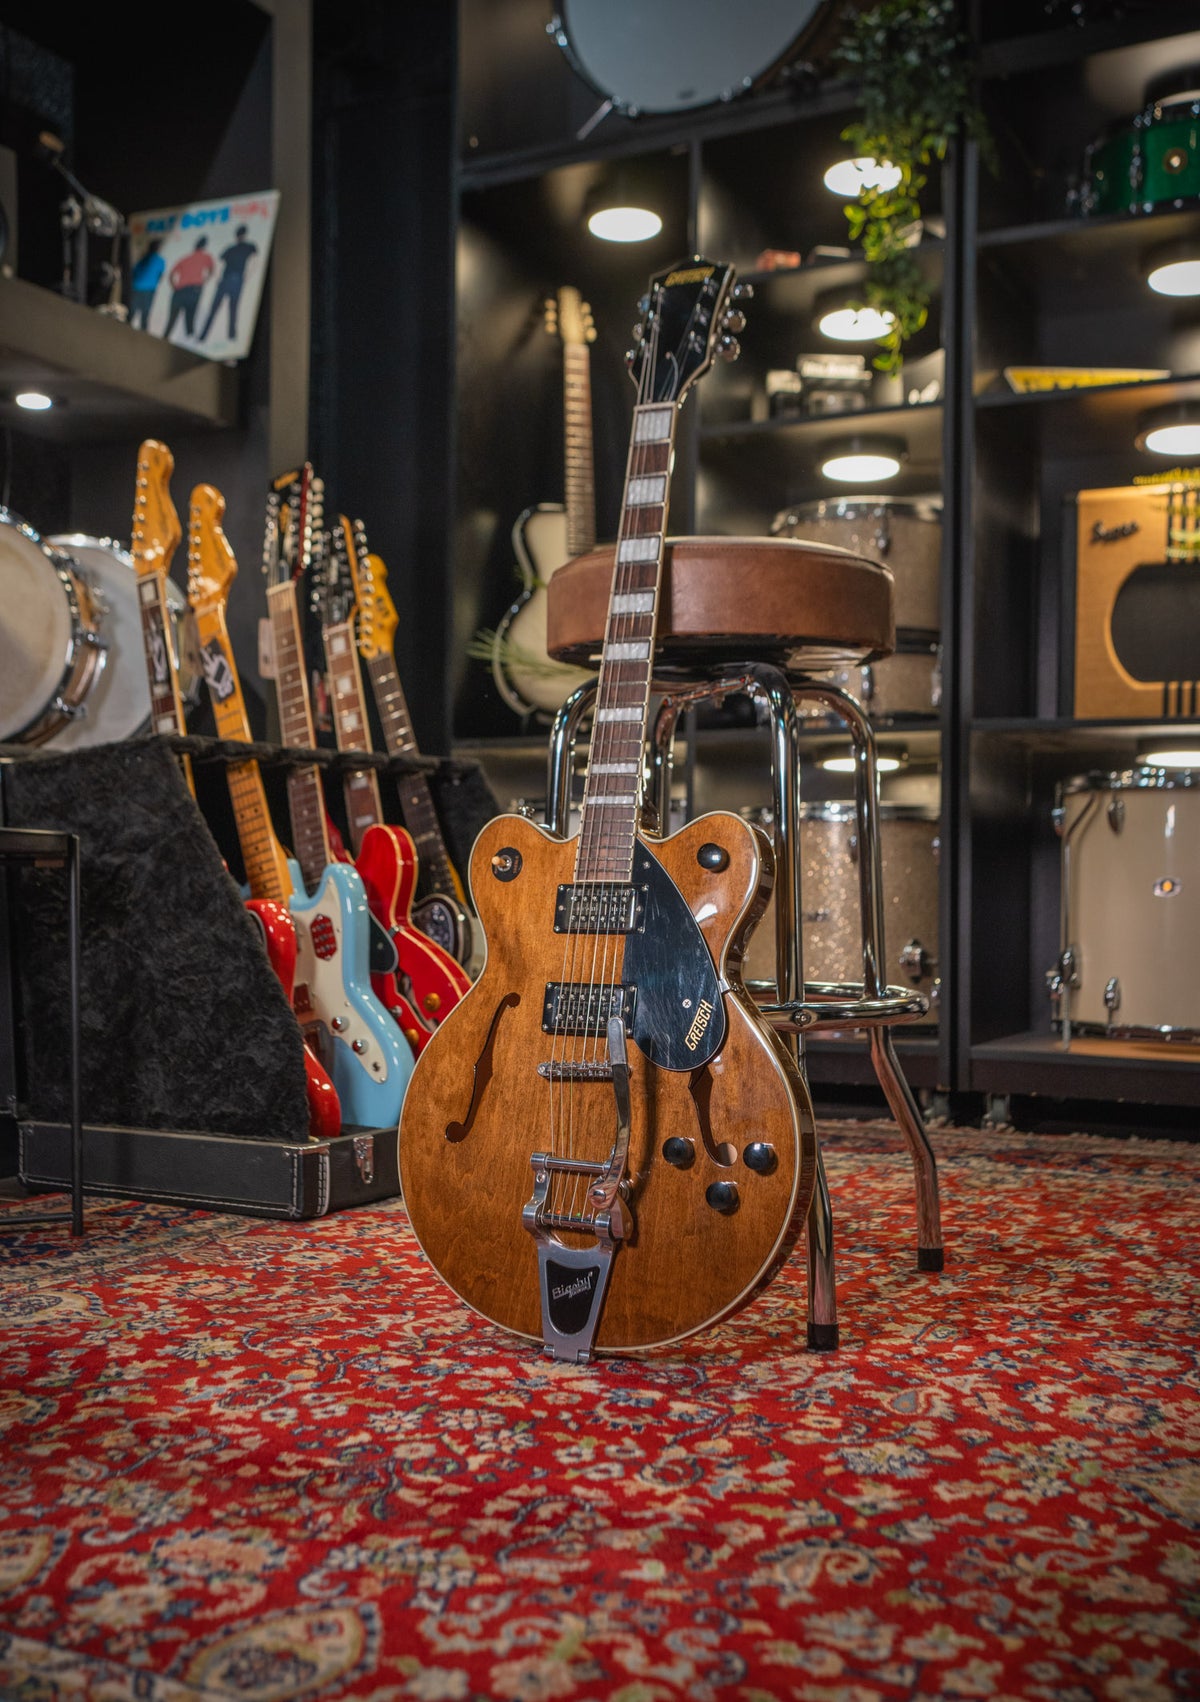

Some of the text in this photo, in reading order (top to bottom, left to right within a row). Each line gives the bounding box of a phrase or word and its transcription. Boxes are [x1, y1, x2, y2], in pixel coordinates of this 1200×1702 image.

[181, 206, 230, 229] BOYS
[685, 999, 713, 1051] GRETSCH
[552, 1271, 593, 1299] Bigsby
